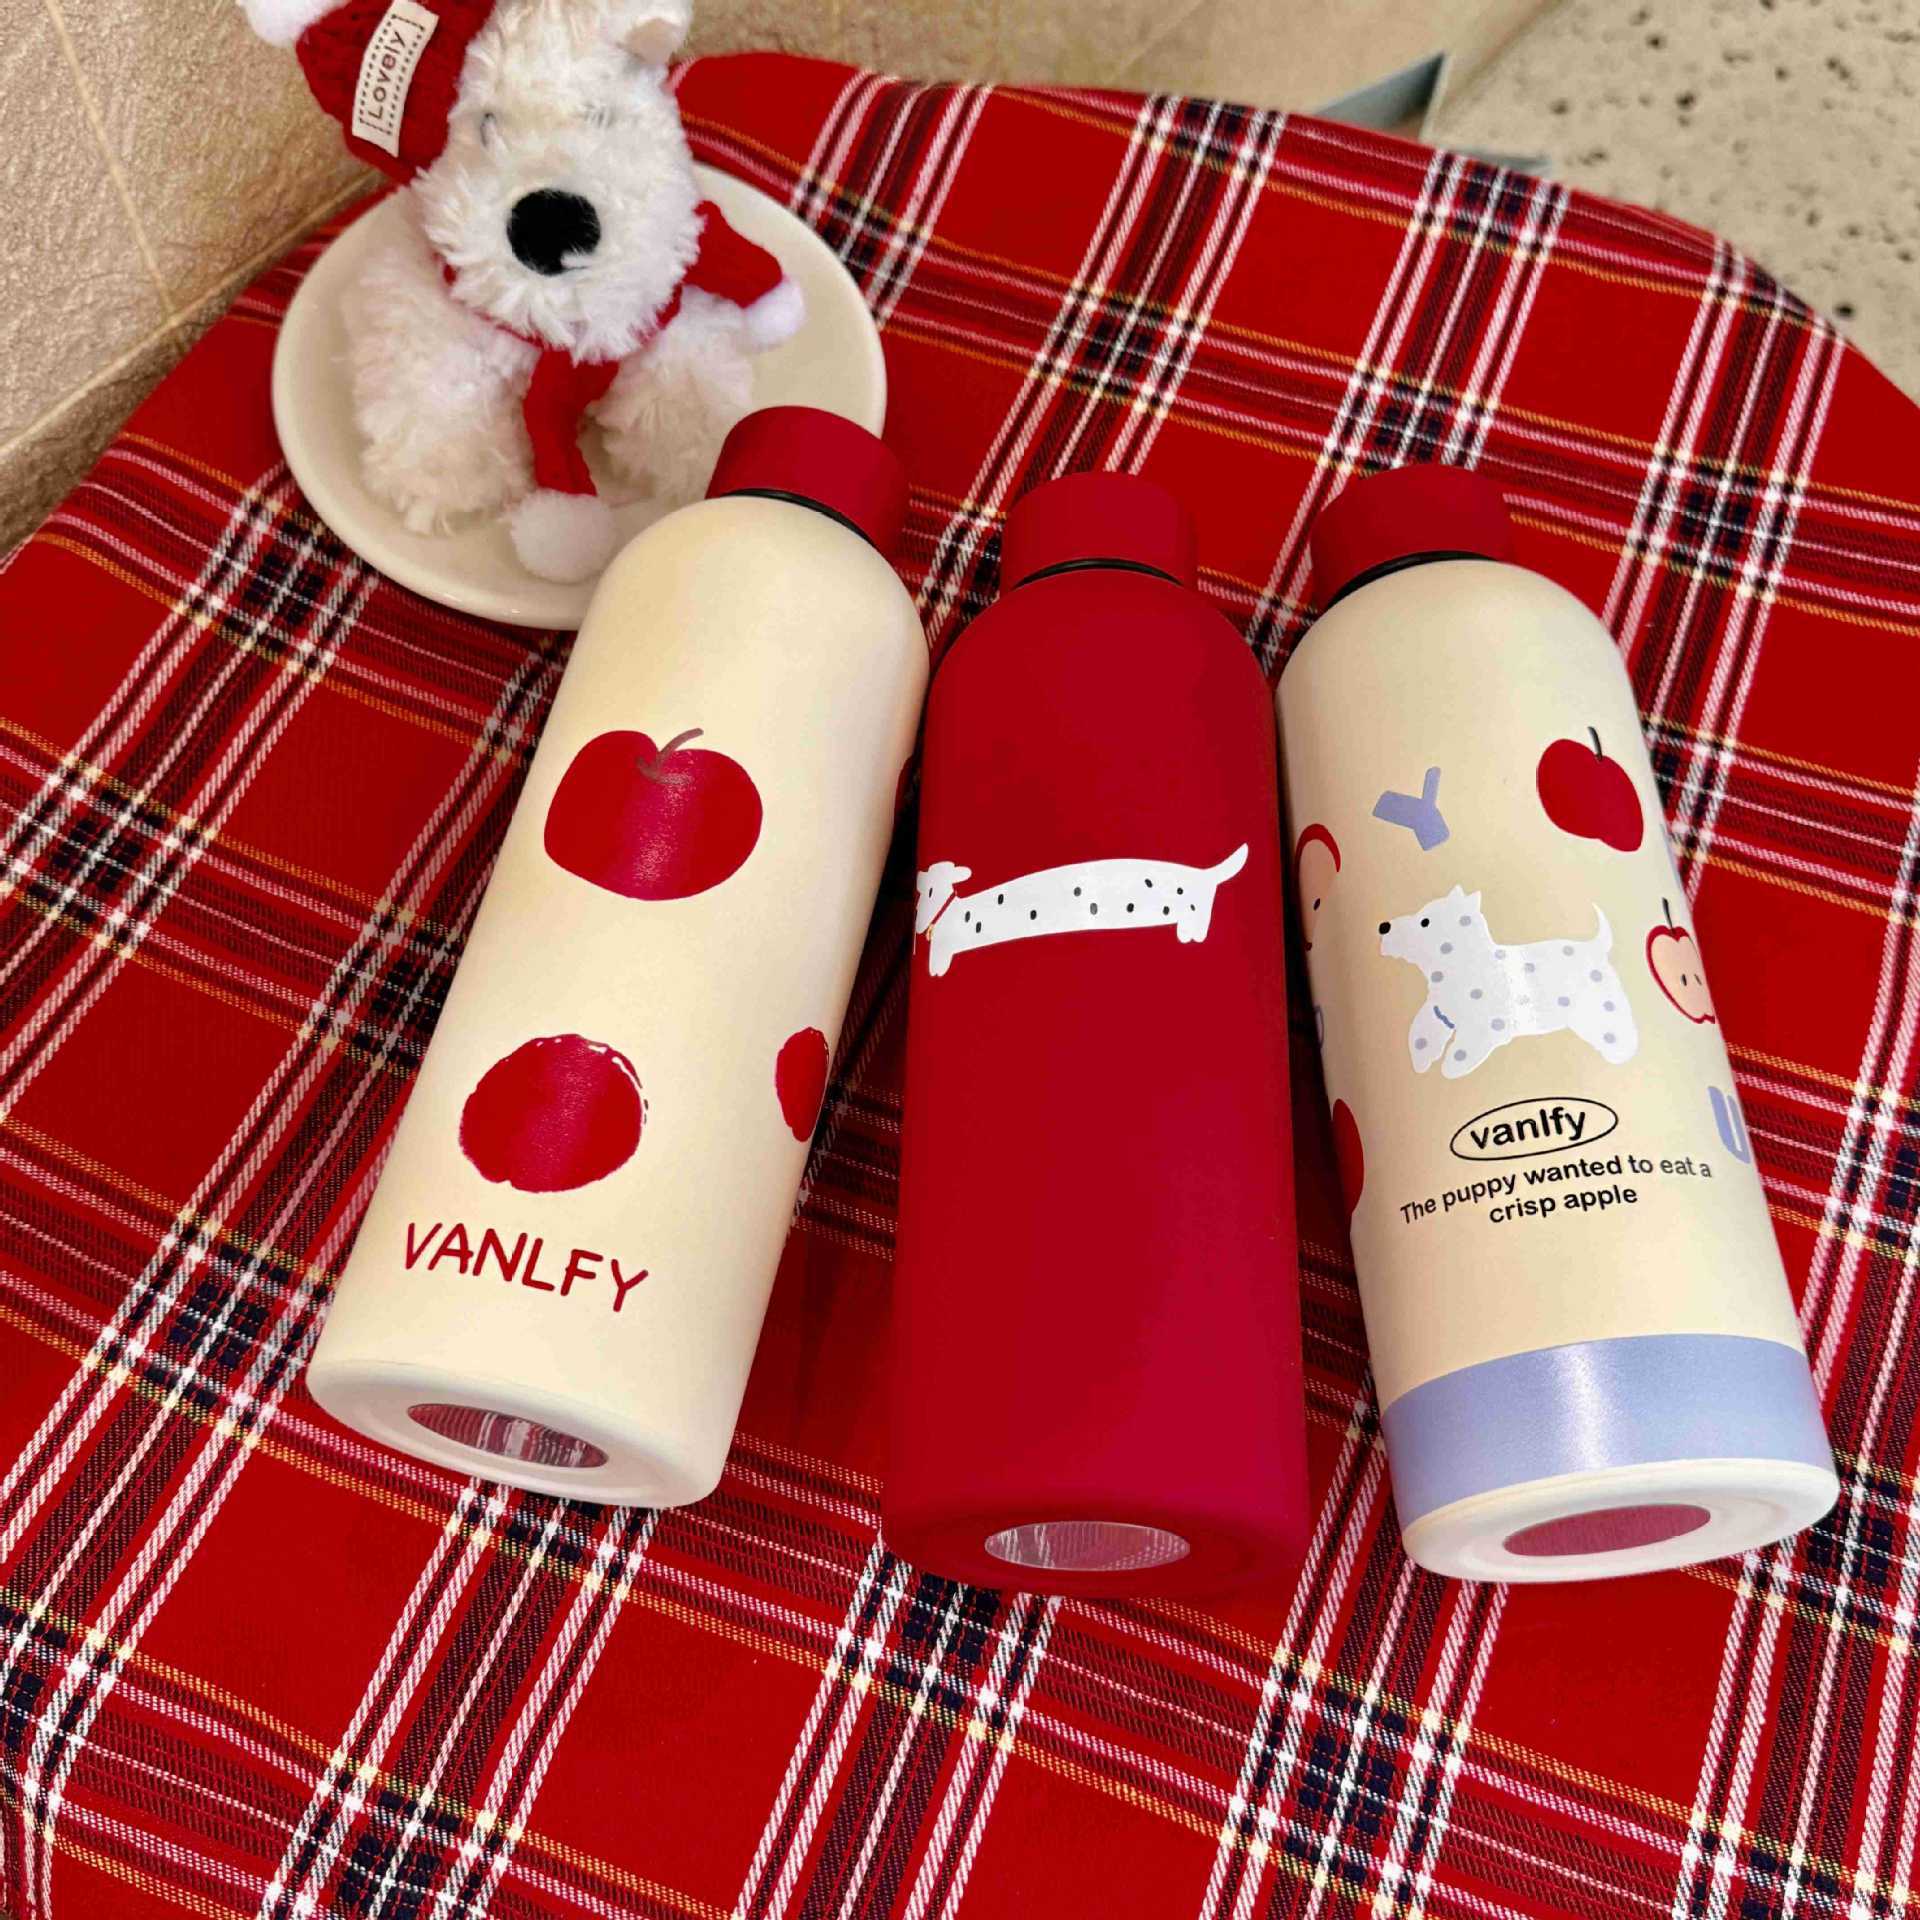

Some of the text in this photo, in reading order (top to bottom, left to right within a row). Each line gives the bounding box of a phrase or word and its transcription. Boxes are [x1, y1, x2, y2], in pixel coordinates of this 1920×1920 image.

[367, 30, 406, 120] Lovely
[1400, 1155, 1712, 1224] The puppy wanted to eat a
[1489, 1185, 1638, 1223] crisp apple
[405, 1222, 649, 1312] VANLFY
